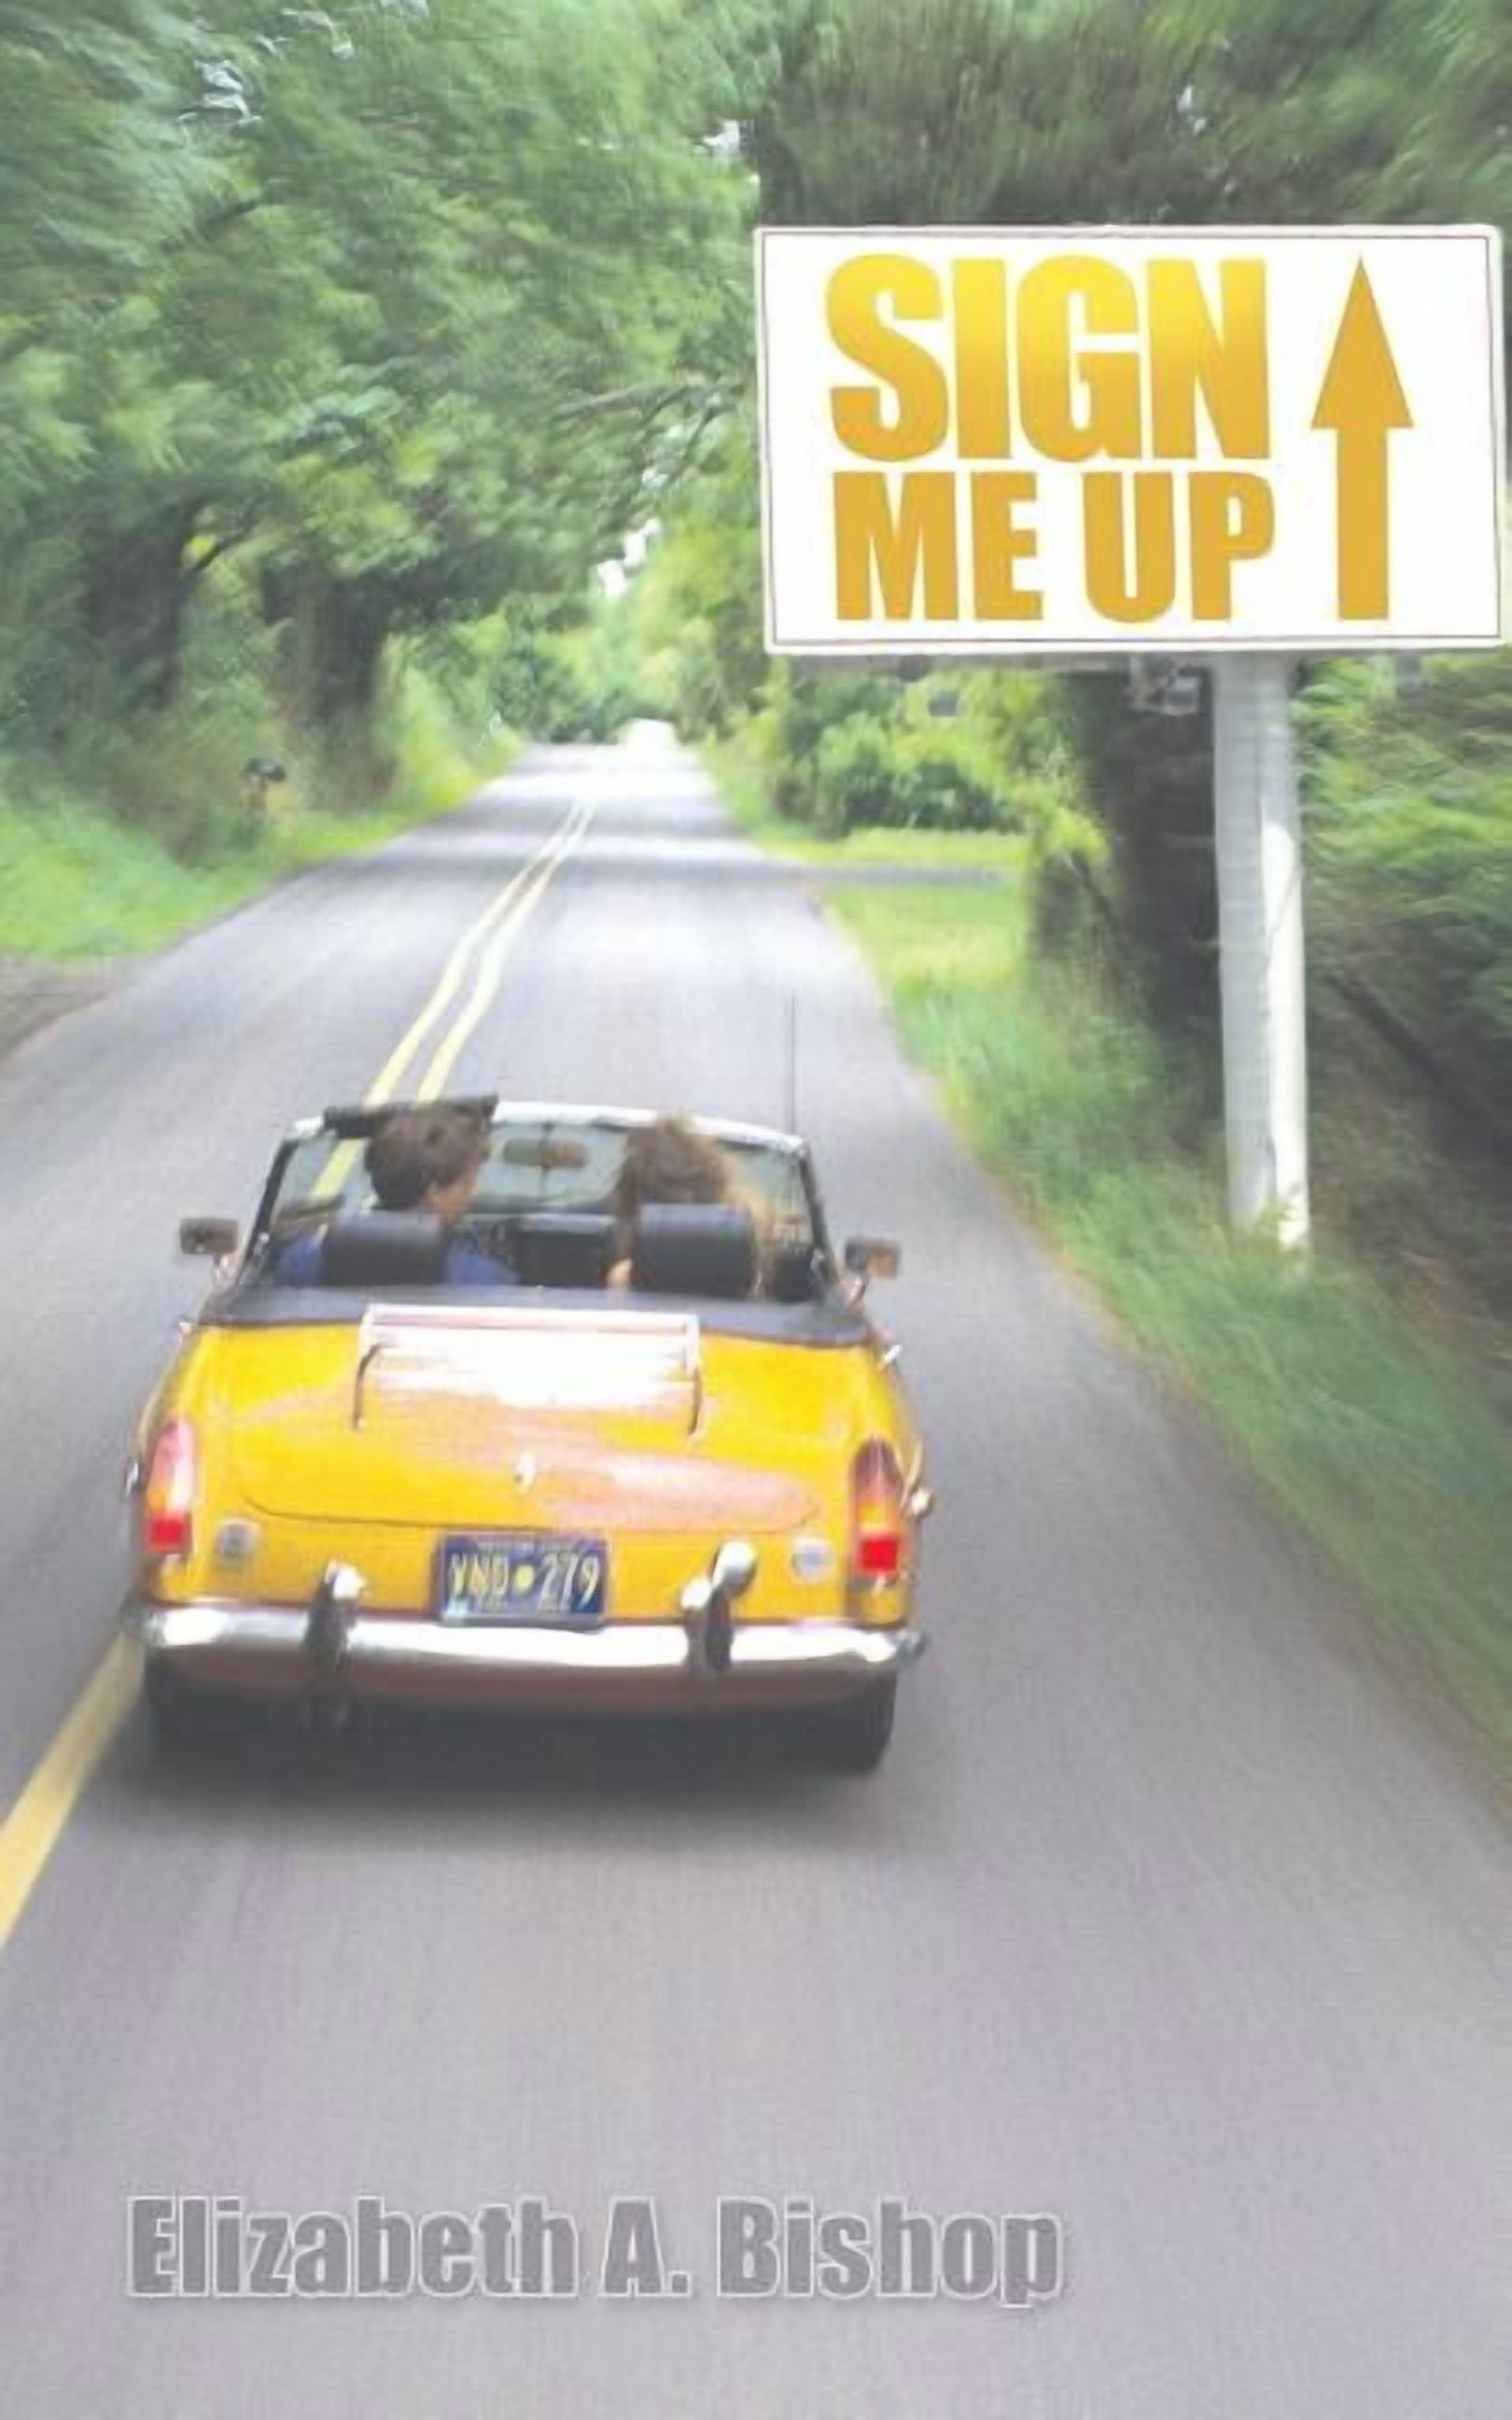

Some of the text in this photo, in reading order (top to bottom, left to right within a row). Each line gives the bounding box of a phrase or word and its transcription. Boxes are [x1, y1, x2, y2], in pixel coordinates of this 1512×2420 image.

[826, 255, 1271, 461] SIGN
[833, 471, 1275, 623] ME UP
